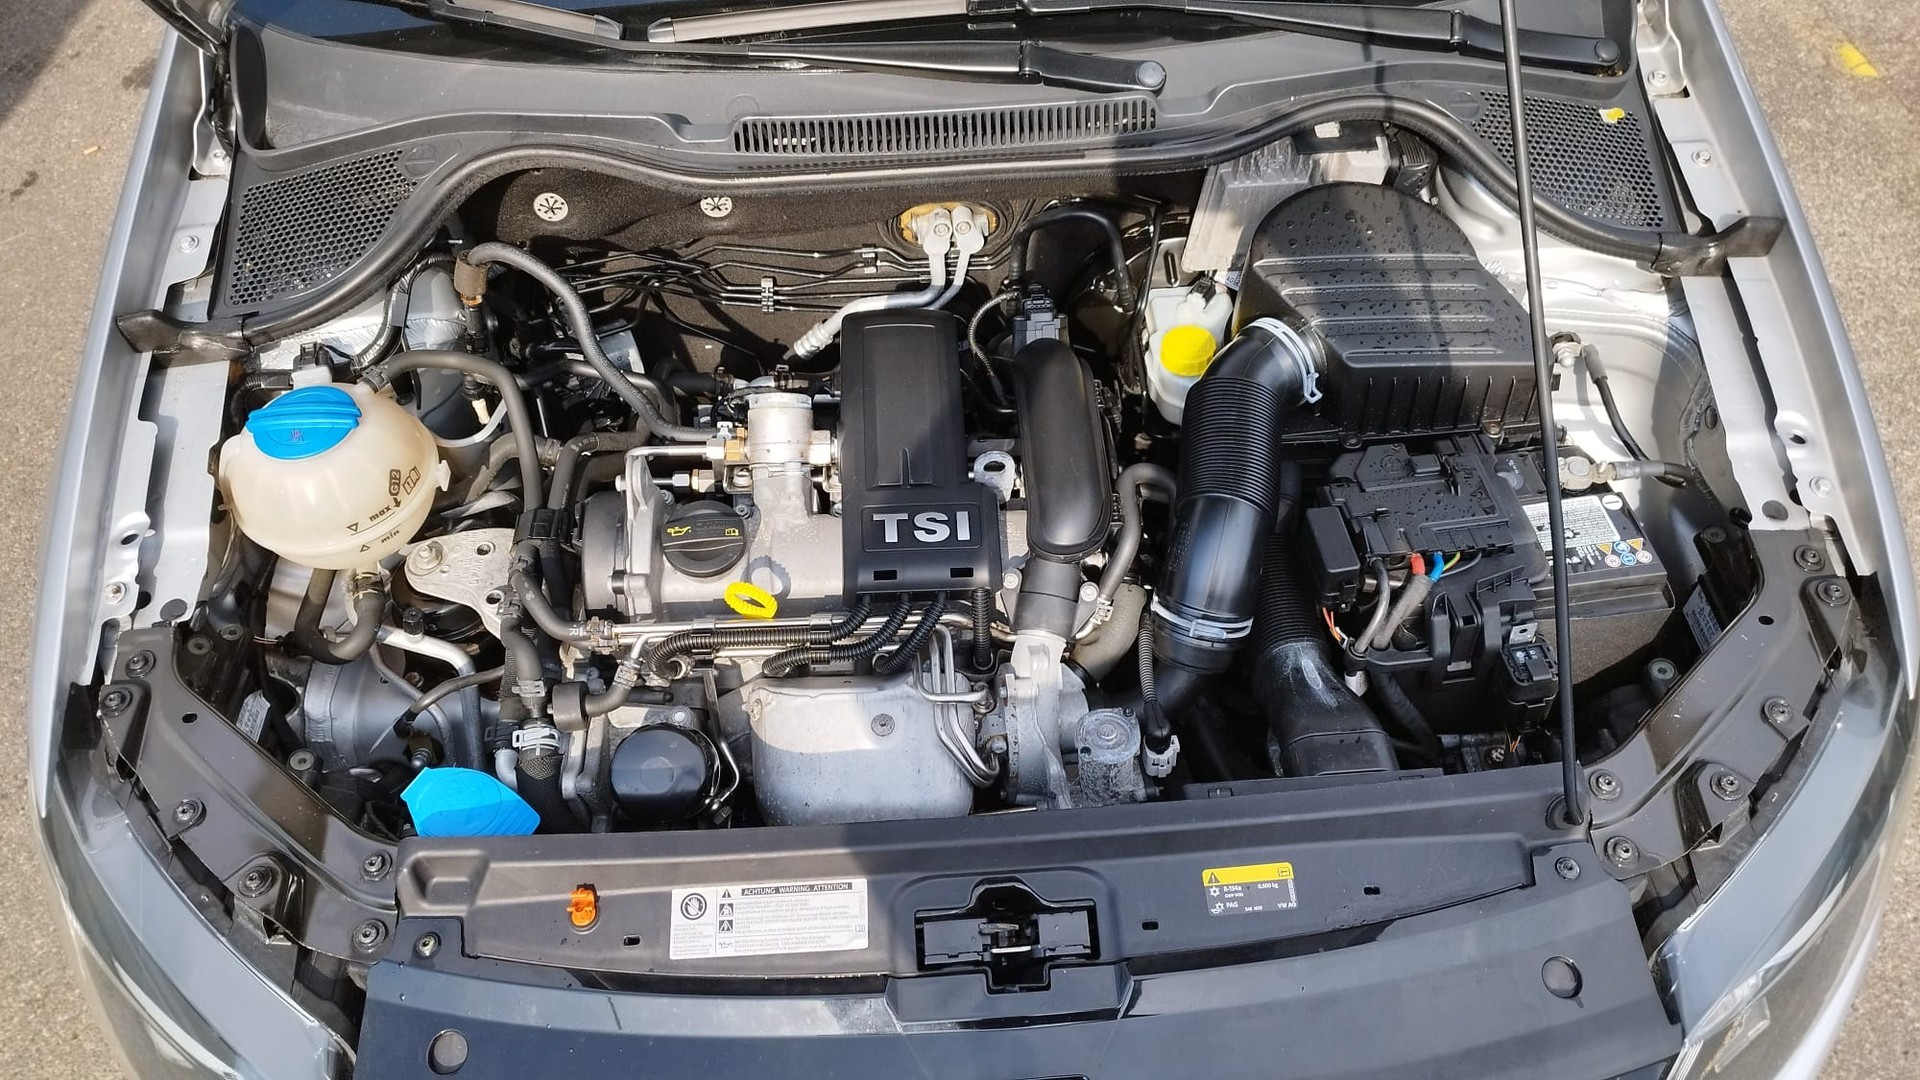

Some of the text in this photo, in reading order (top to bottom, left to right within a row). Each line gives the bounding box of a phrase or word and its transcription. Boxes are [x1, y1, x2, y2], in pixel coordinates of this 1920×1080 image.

[390, 470, 400, 494] G12
[369, 505, 391, 521] max
[872, 511, 971, 543] TSI
[381, 530, 400, 543] min
[743, 883, 849, 896] ACHTUNG WARNING ATTENTION
